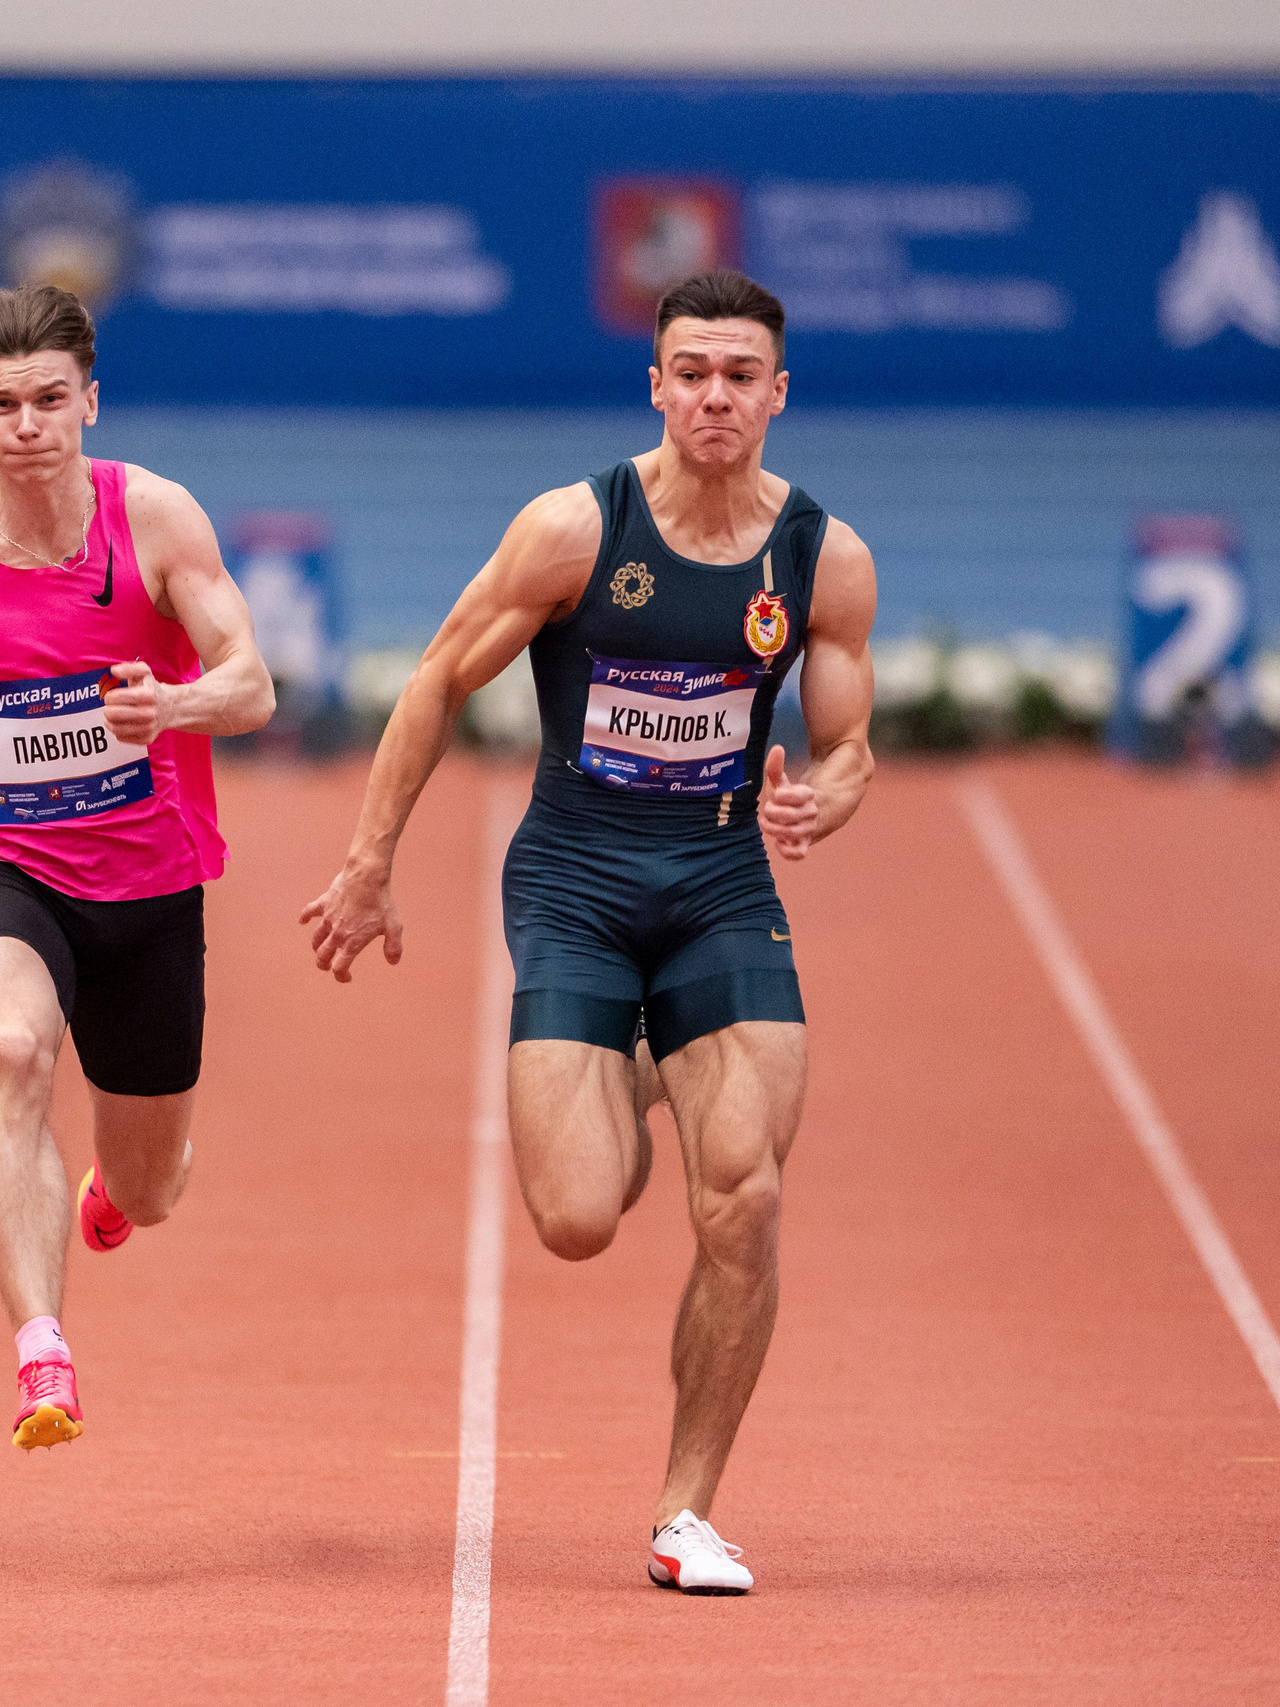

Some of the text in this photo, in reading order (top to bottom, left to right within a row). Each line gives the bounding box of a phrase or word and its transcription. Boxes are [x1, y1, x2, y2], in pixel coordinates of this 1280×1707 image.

[1133, 556, 1248, 721] 2
[606, 667, 727, 695] Русская Зима
[652, 683, 680, 694] 2024
[26, 702, 51, 715] 2024
[52, 682, 100, 710] Зима
[608, 705, 732, 743] КРЫЛОВ К.
[12, 725, 108, 765] ПАВЛОВ
